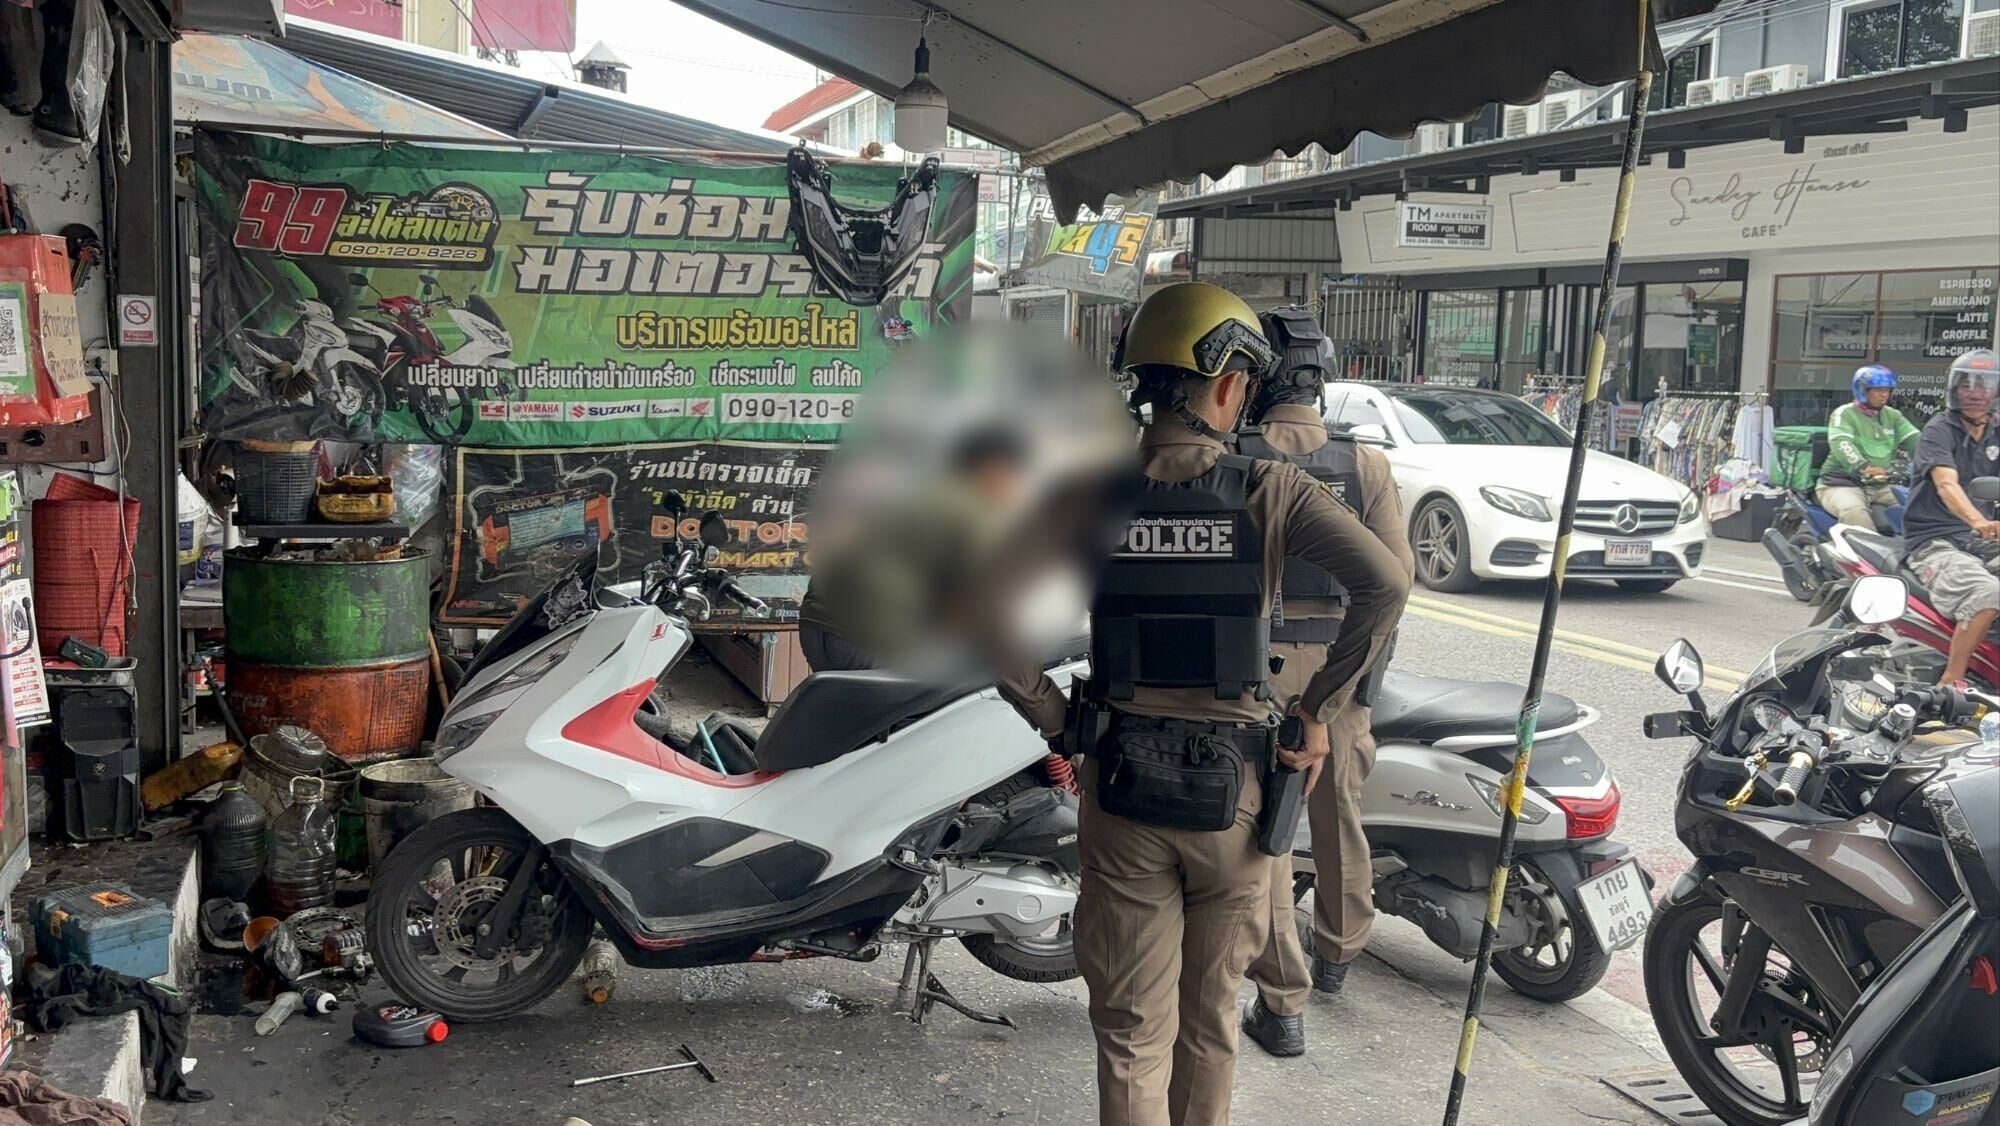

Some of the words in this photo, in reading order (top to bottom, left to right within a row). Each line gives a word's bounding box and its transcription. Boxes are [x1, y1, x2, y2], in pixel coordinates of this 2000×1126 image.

[1669, 172, 1762, 226] Sunday
[1773, 163, 1871, 226] House
[523, 171, 790, 240] รับซ่อม
[1029, 196, 1057, 219] PC
[1407, 206, 1431, 221] TM
[1434, 212, 1487, 221] APARTMENT
[233, 179, 347, 256] 99
[1412, 223, 1438, 232] ROOM
[1441, 225, 1455, 233] FOR
[1458, 224, 1480, 234] RENT
[338, 244, 478, 259] 090-120-8226
[1940, 278, 1992, 289] ESPRESSO
[1931, 296, 1990, 306] AMERICANO
[617, 305, 860, 349] บริการพร้อมอะไหล่
[1956, 312, 1988, 323] LATTE
[1942, 329, 1988, 340] CROFFLE
[1929, 346, 1986, 357] ICE-CRE
[407, 358, 498, 388] เปลี่ยนยาง
[1897, 375, 1934, 383] CROISSANTS
[522, 403, 560, 413] YAMAHA
[588, 404, 641, 416] SUZUKI
[650, 515, 810, 544] DOTOR
[1595, 870, 1628, 900] 1กย
[1739, 866, 1811, 886] CBR
[1608, 895, 1630, 916] ชลบุรี
[1608, 911, 1648, 943] 4493
